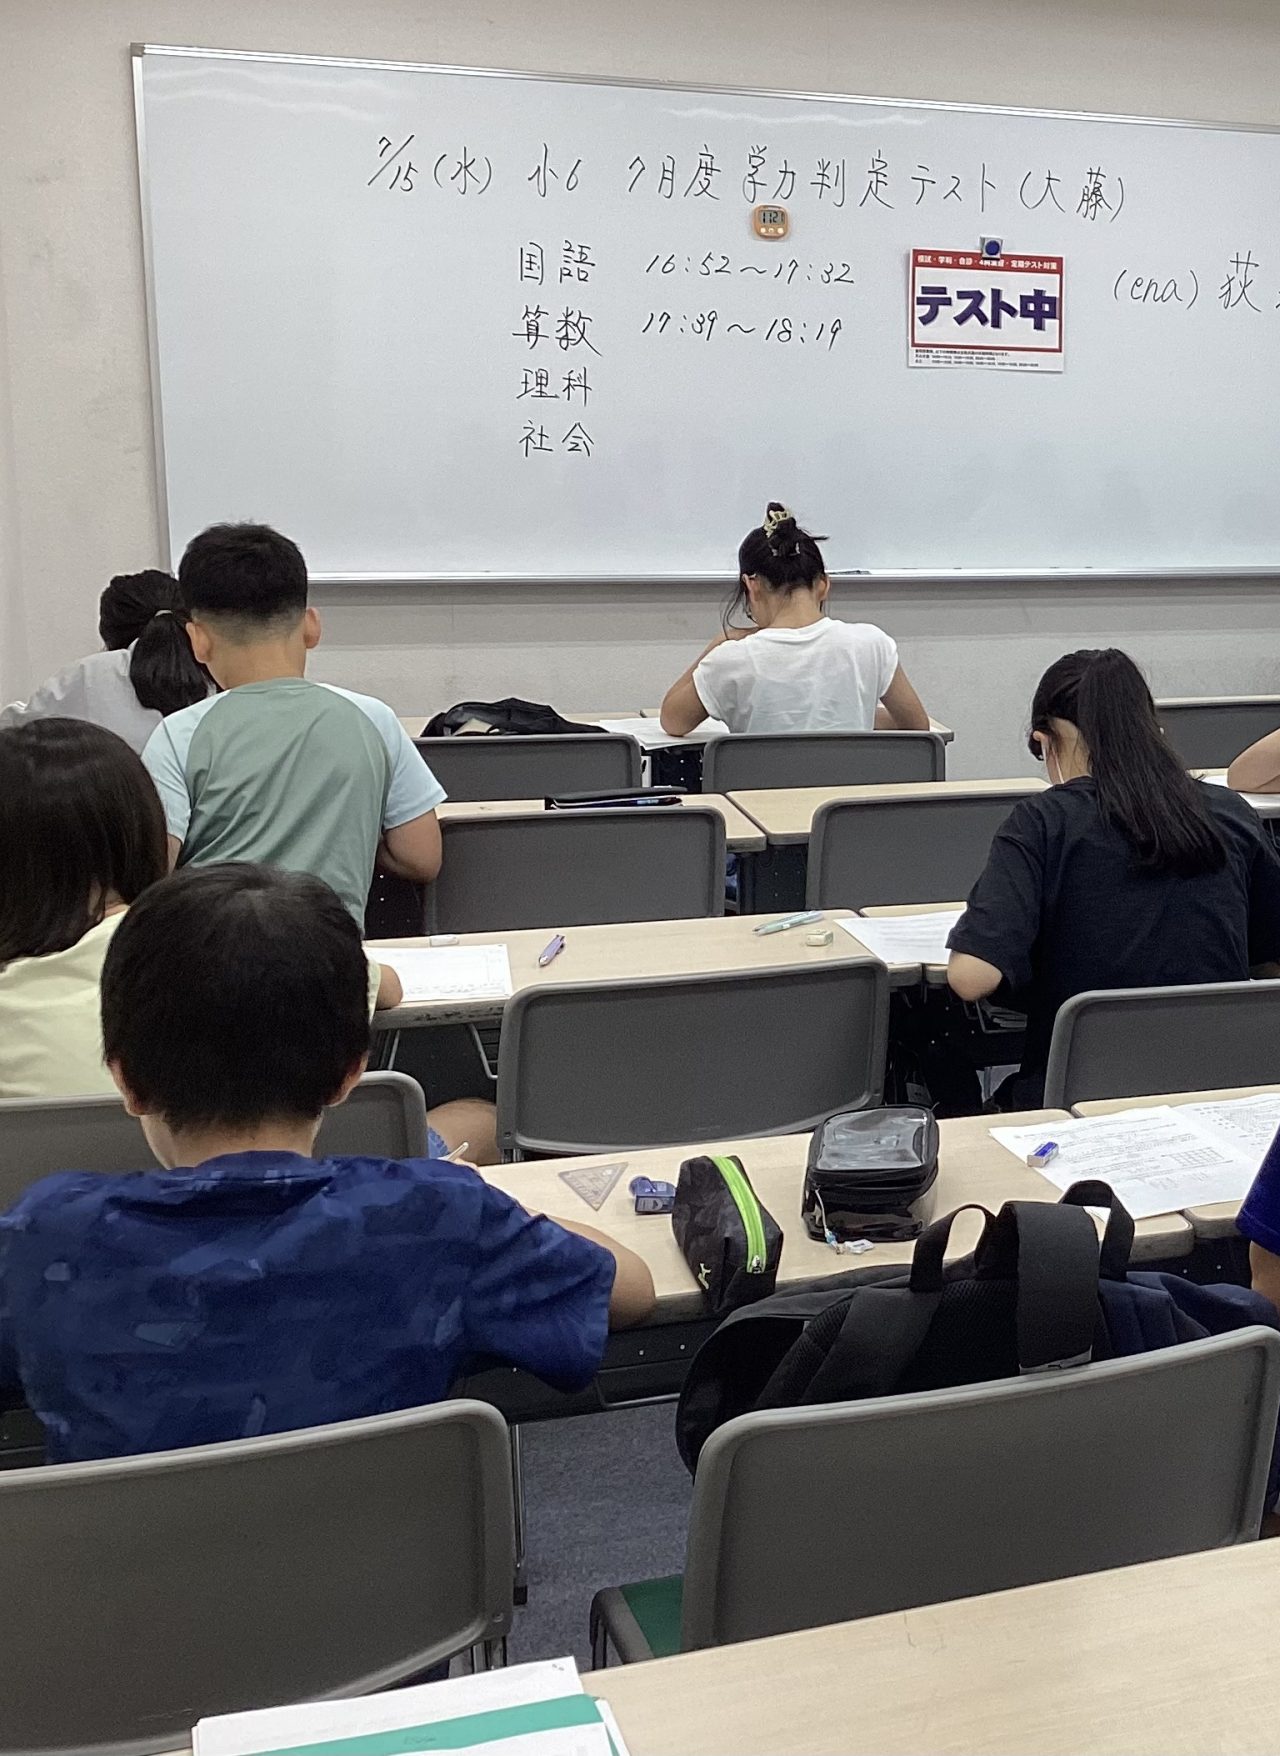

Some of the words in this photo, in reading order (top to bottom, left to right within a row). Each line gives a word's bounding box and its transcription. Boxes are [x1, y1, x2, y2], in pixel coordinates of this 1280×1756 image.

[527, 142, 582, 198] 小6
[519, 239, 596, 286] 国語
[511, 304, 603, 357] 算数
[915, 285, 1059, 331] テスト中
[515, 366, 593, 407] 理科
[518, 419, 595, 458] 社会
